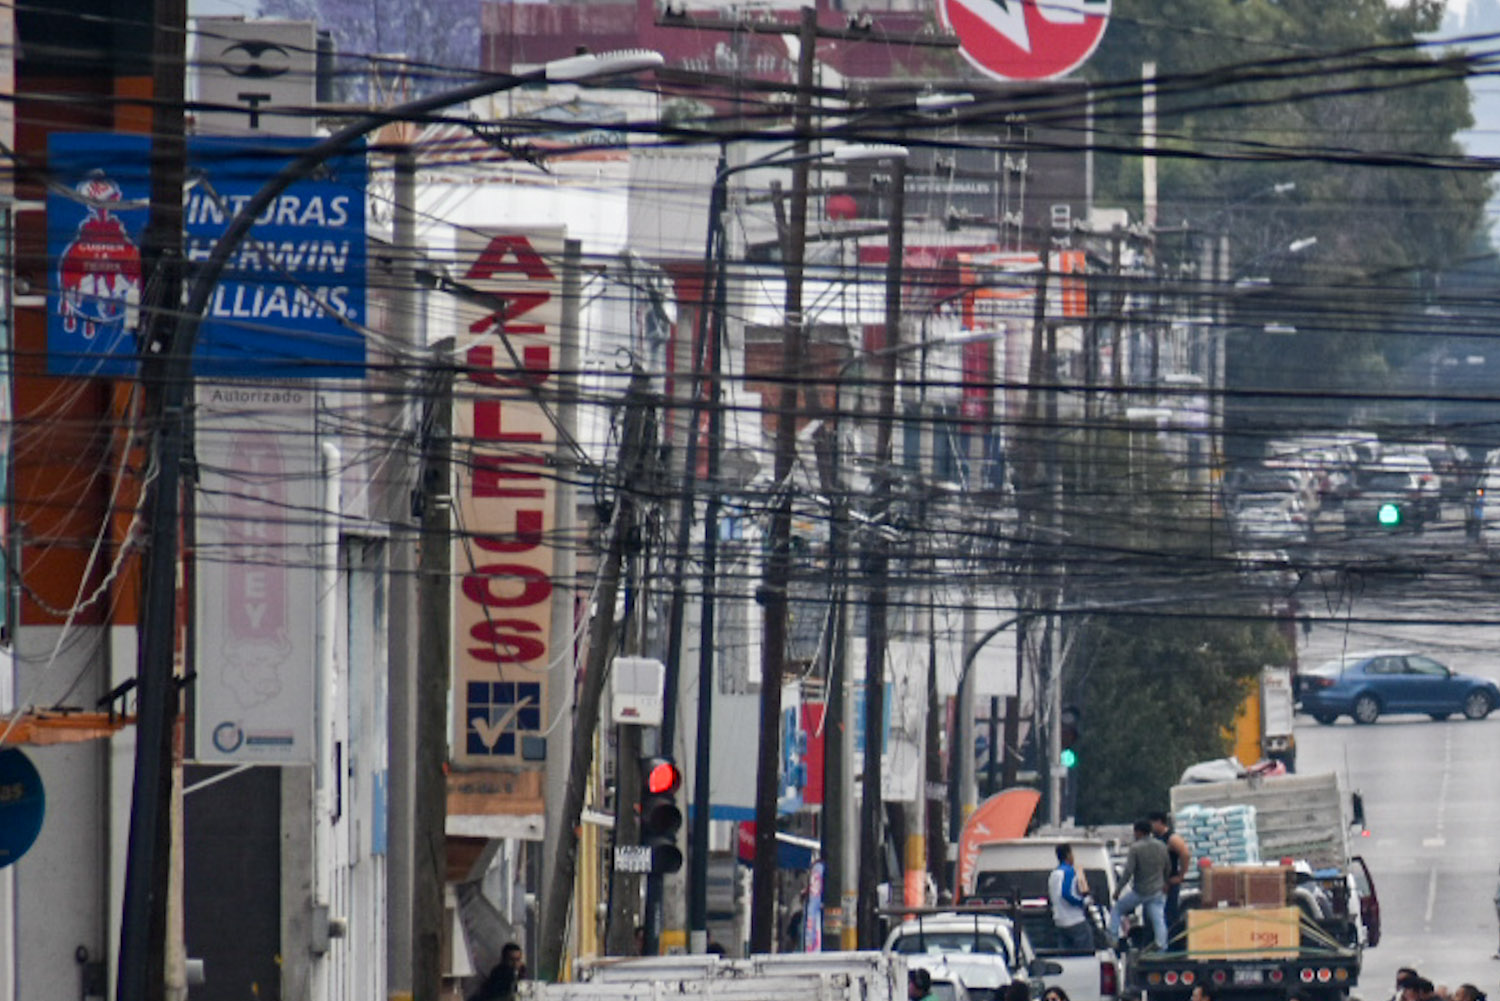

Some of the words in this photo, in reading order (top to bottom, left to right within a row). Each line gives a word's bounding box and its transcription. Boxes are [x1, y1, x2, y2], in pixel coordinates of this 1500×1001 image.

[186, 196, 349, 226] INTURAS
[189, 240, 349, 273] HERWIN
[202, 286, 348, 318] ILLIAMS
[211, 389, 303, 404] Autorizado
[462, 235, 556, 664] AZULEJOS
